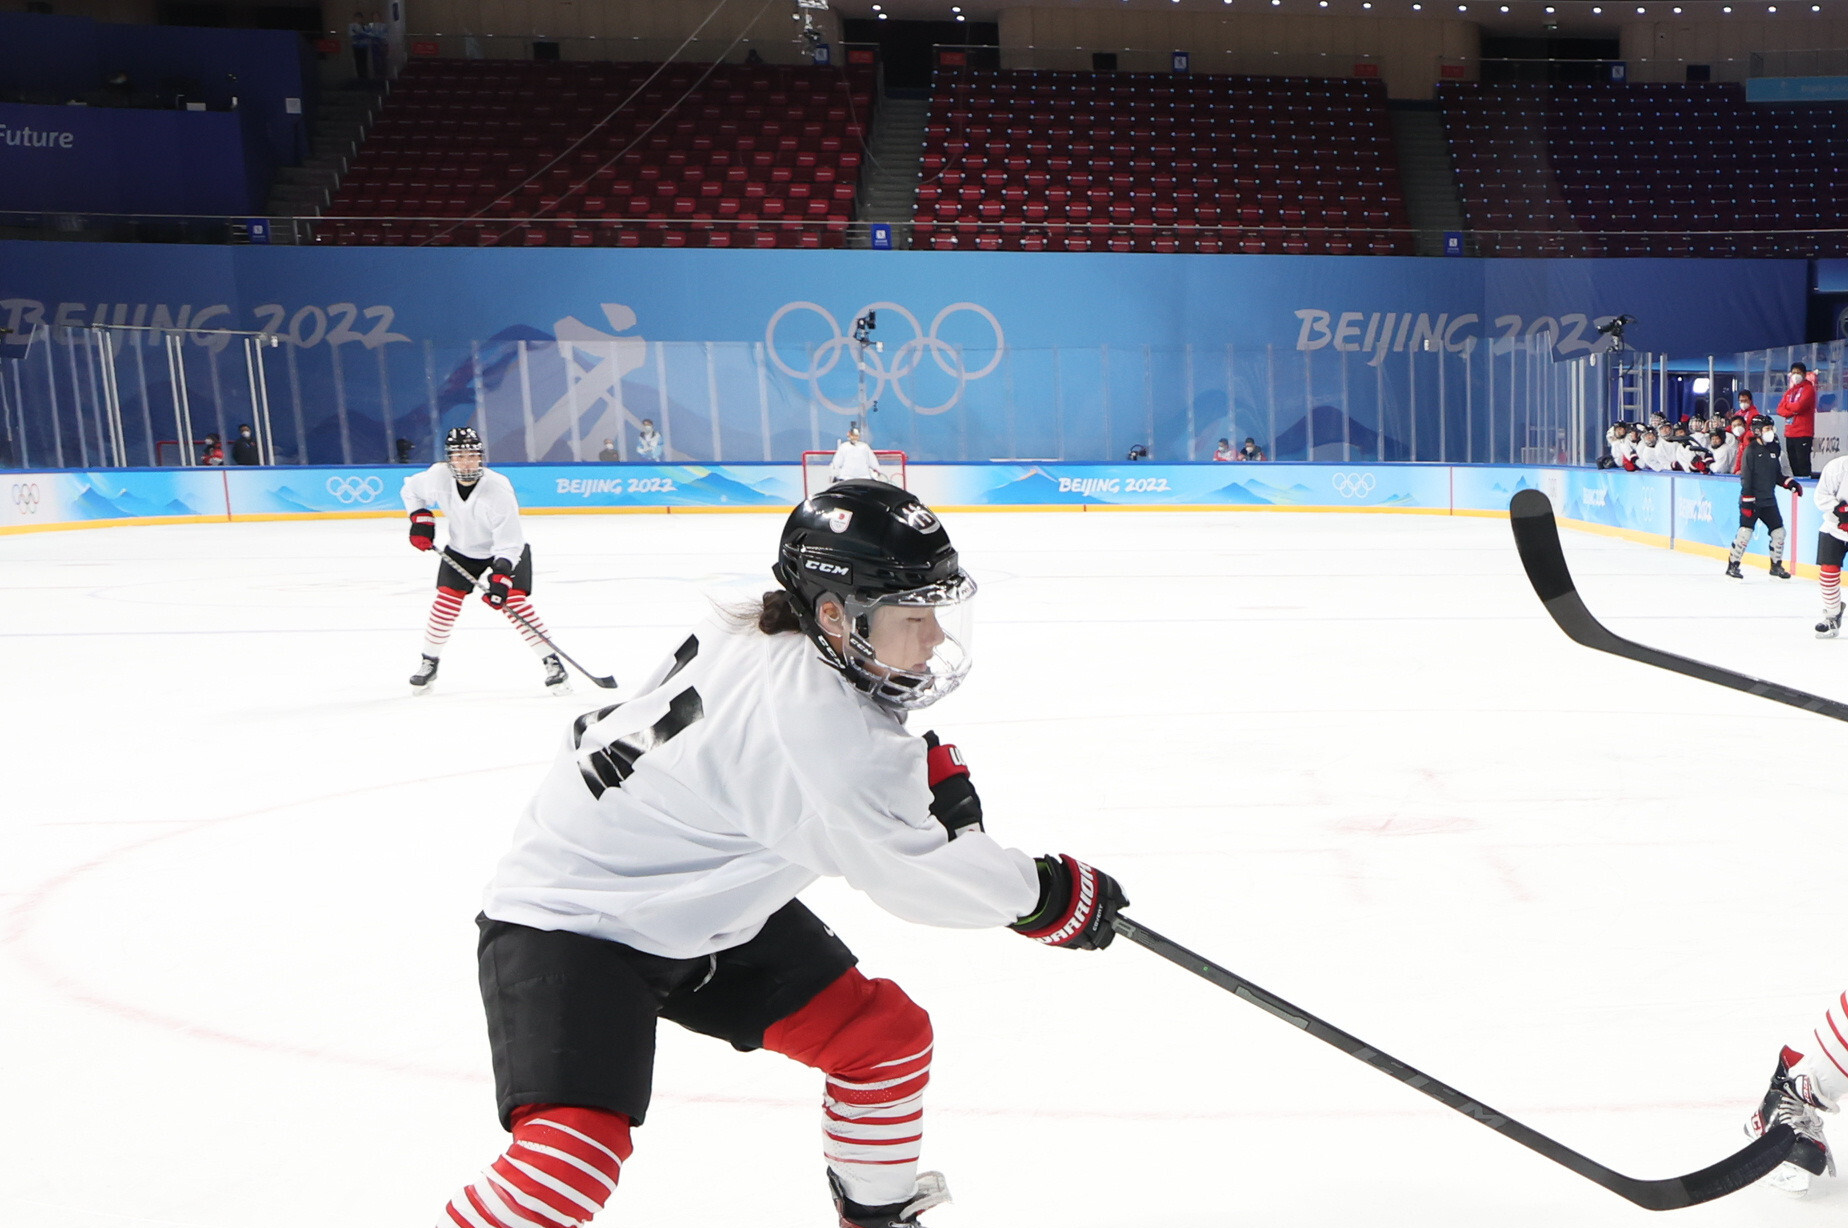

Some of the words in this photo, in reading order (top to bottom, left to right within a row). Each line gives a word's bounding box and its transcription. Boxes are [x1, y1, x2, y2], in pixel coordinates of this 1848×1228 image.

[2, 299, 231, 360] BEIJING
[254, 303, 413, 350] 2022
[1294, 308, 1479, 367] BEIJING
[557, 478, 622, 497] BEIJING
[627, 478, 678, 493] 2022
[1058, 477, 1120, 497] BEIJING
[1124, 477, 1172, 493] 2022
[805, 559, 850, 576] CCM
[818, 635, 846, 669] CCM
[850, 638, 873, 656] CCM
